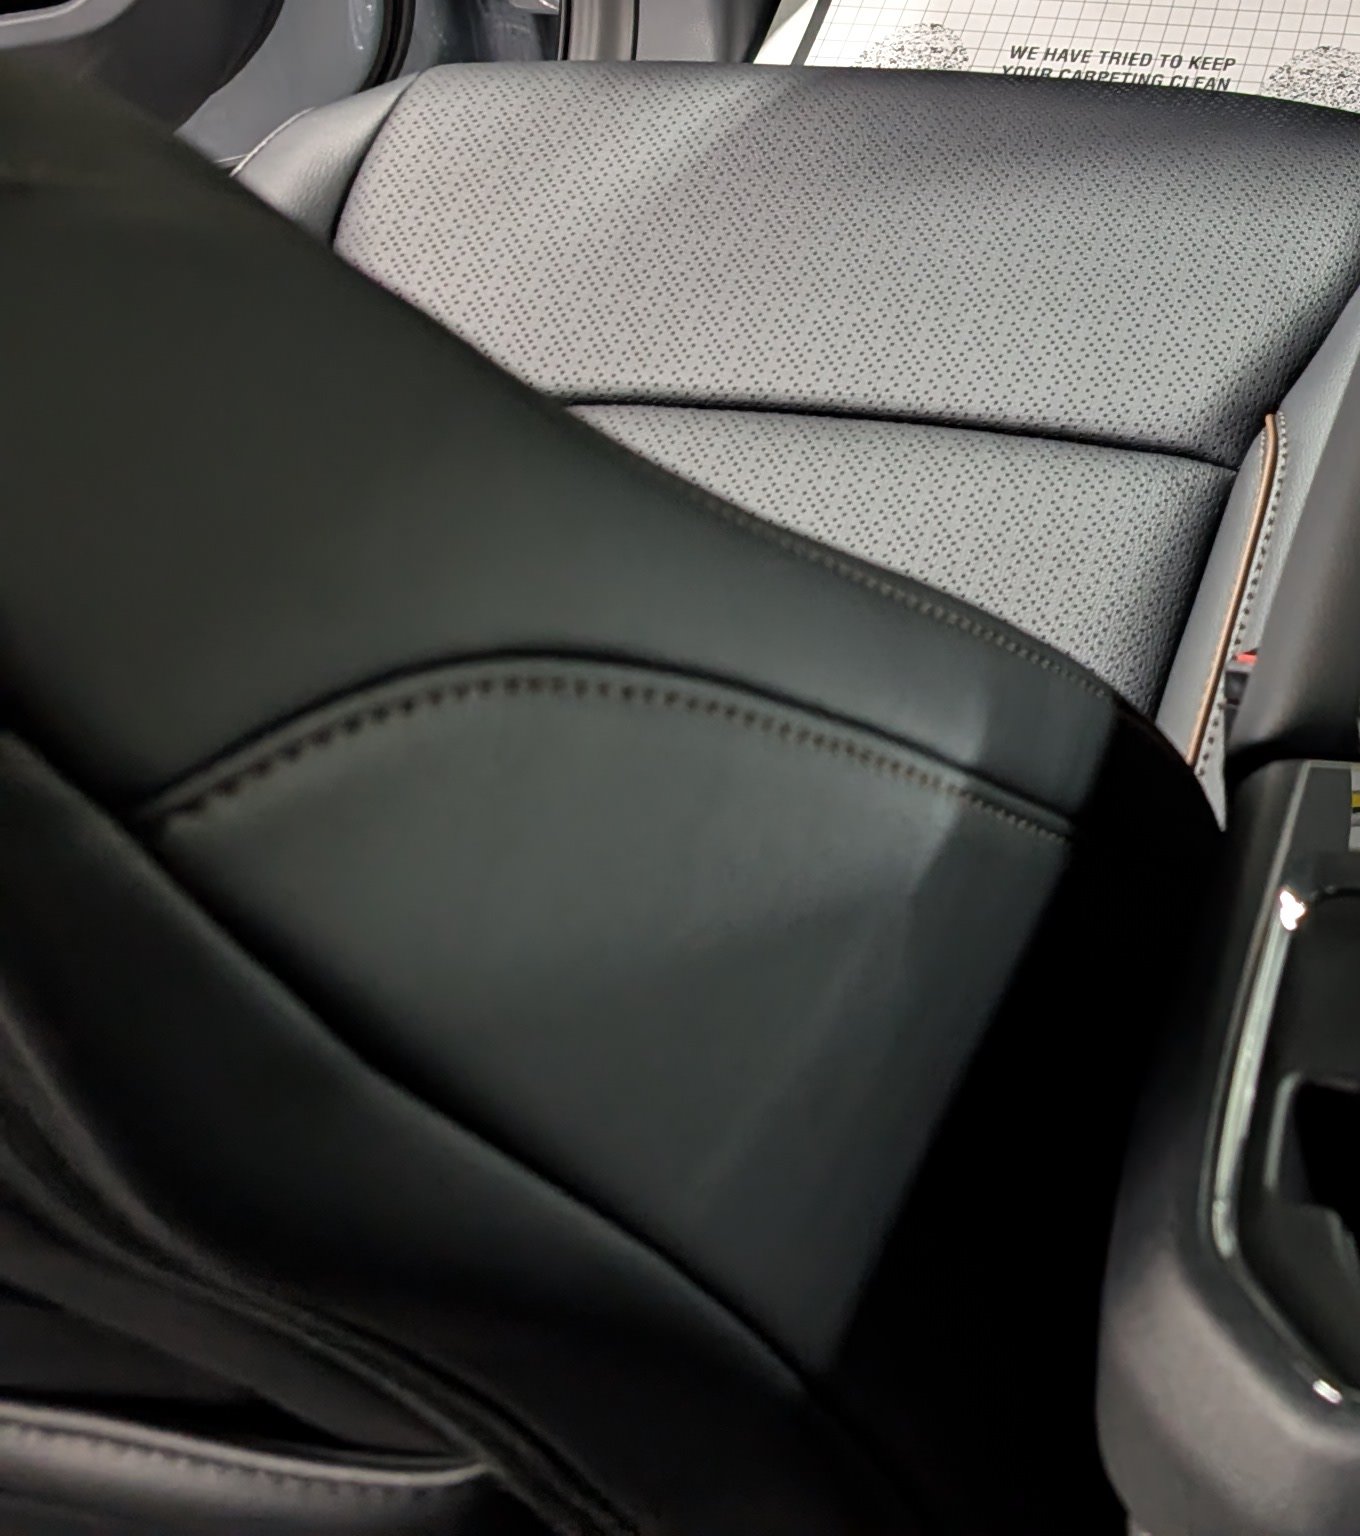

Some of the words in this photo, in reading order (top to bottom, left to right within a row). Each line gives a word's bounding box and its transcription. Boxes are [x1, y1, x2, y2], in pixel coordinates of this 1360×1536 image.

[1009, 45, 1040, 61] WE
[1042, 47, 1094, 64] HAVE
[1099, 50, 1153, 67] TRIED
[1159, 53, 1183, 69] TO
[1187, 55, 1236, 72] KEEP
